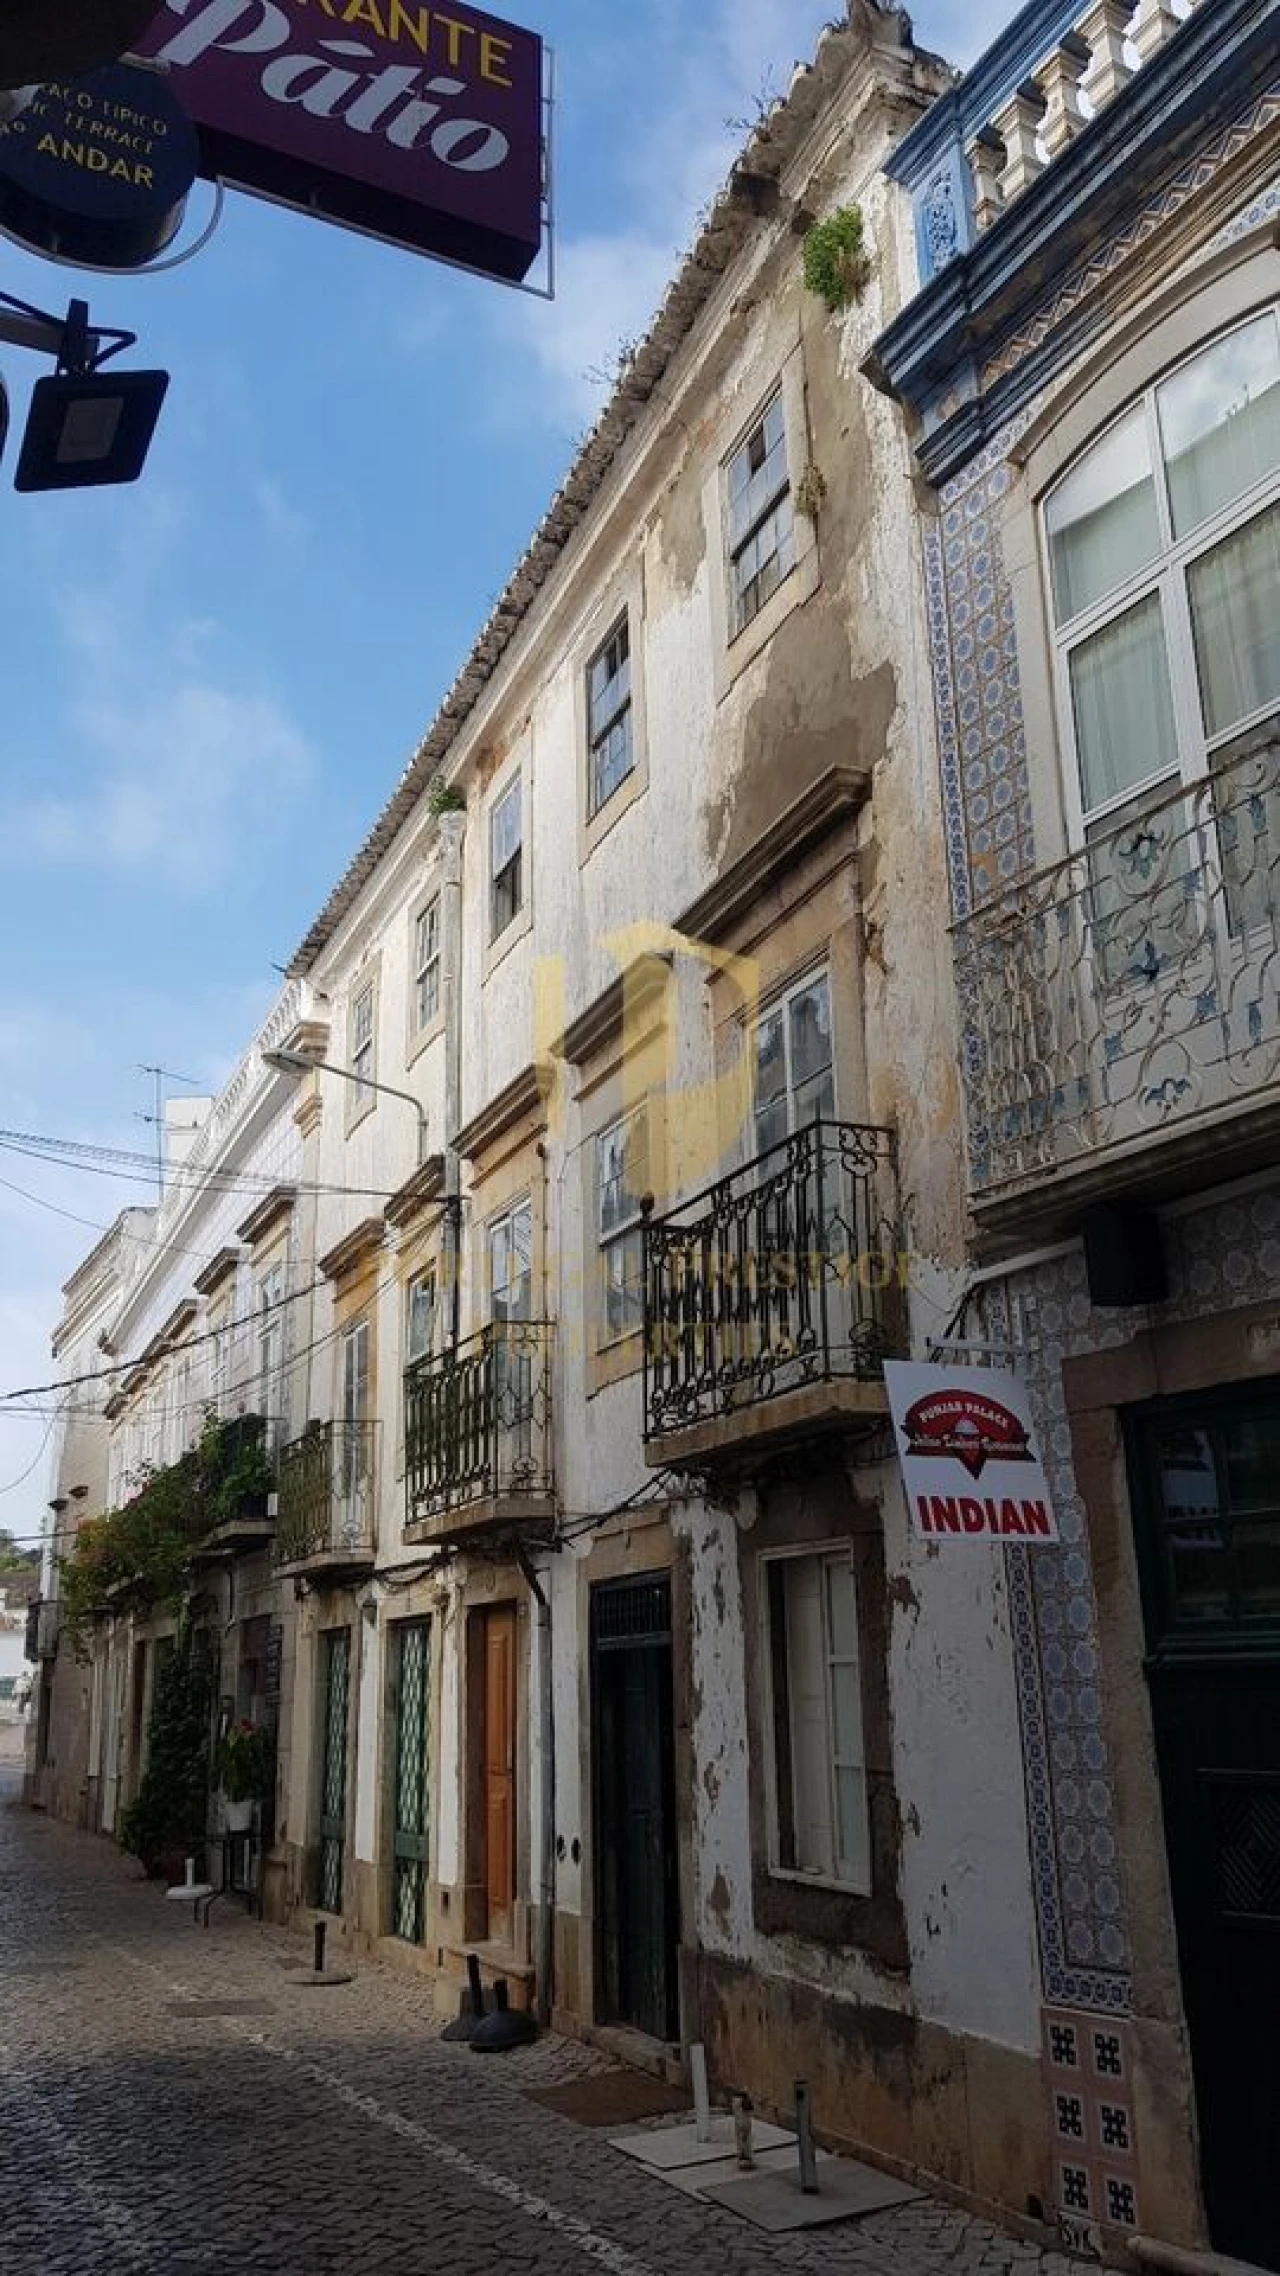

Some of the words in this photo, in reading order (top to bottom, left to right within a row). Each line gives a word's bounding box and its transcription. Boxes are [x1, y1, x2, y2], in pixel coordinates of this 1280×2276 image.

[37, 132, 152, 190] ANDAR
[918, 1400, 963, 1423] PUNJAB
[964, 1402, 1009, 1429] PALACE
[916, 1495, 1051, 1536] INDIAN
